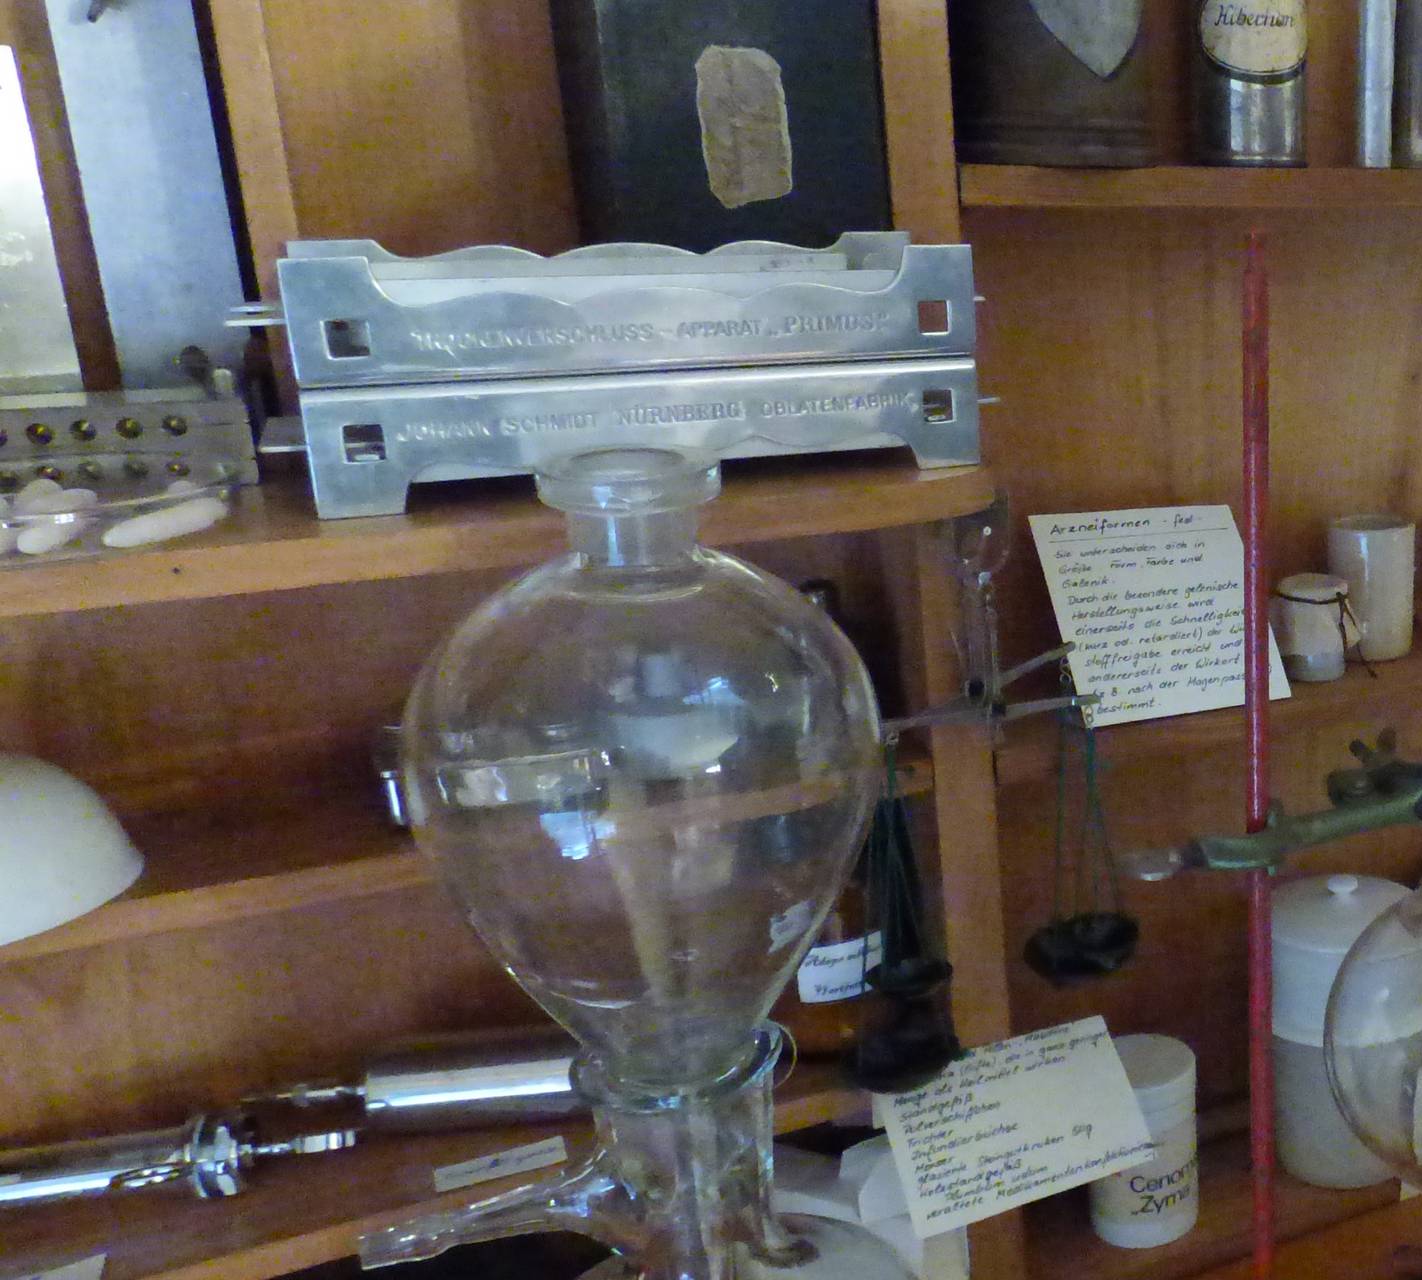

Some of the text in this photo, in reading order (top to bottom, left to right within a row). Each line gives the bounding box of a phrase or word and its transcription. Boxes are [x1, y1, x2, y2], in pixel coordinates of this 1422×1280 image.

[676, 319, 762, 338] APPARAT
[397, 421, 490, 442] JOHANN
[500, 411, 600, 436] SCHMIDT
[618, 401, 745, 427] NÜRNBERG
[1050, 517, 1150, 535] Arzneiformen
[1079, 543, 1157, 558] unterscheiden
[1194, 538, 1205, 548] in
[1180, 553, 1204, 564] und
[1067, 594, 1098, 606] Durch
[1170, 661, 1188, 672] der
[1158, 679, 1179, 690] der
